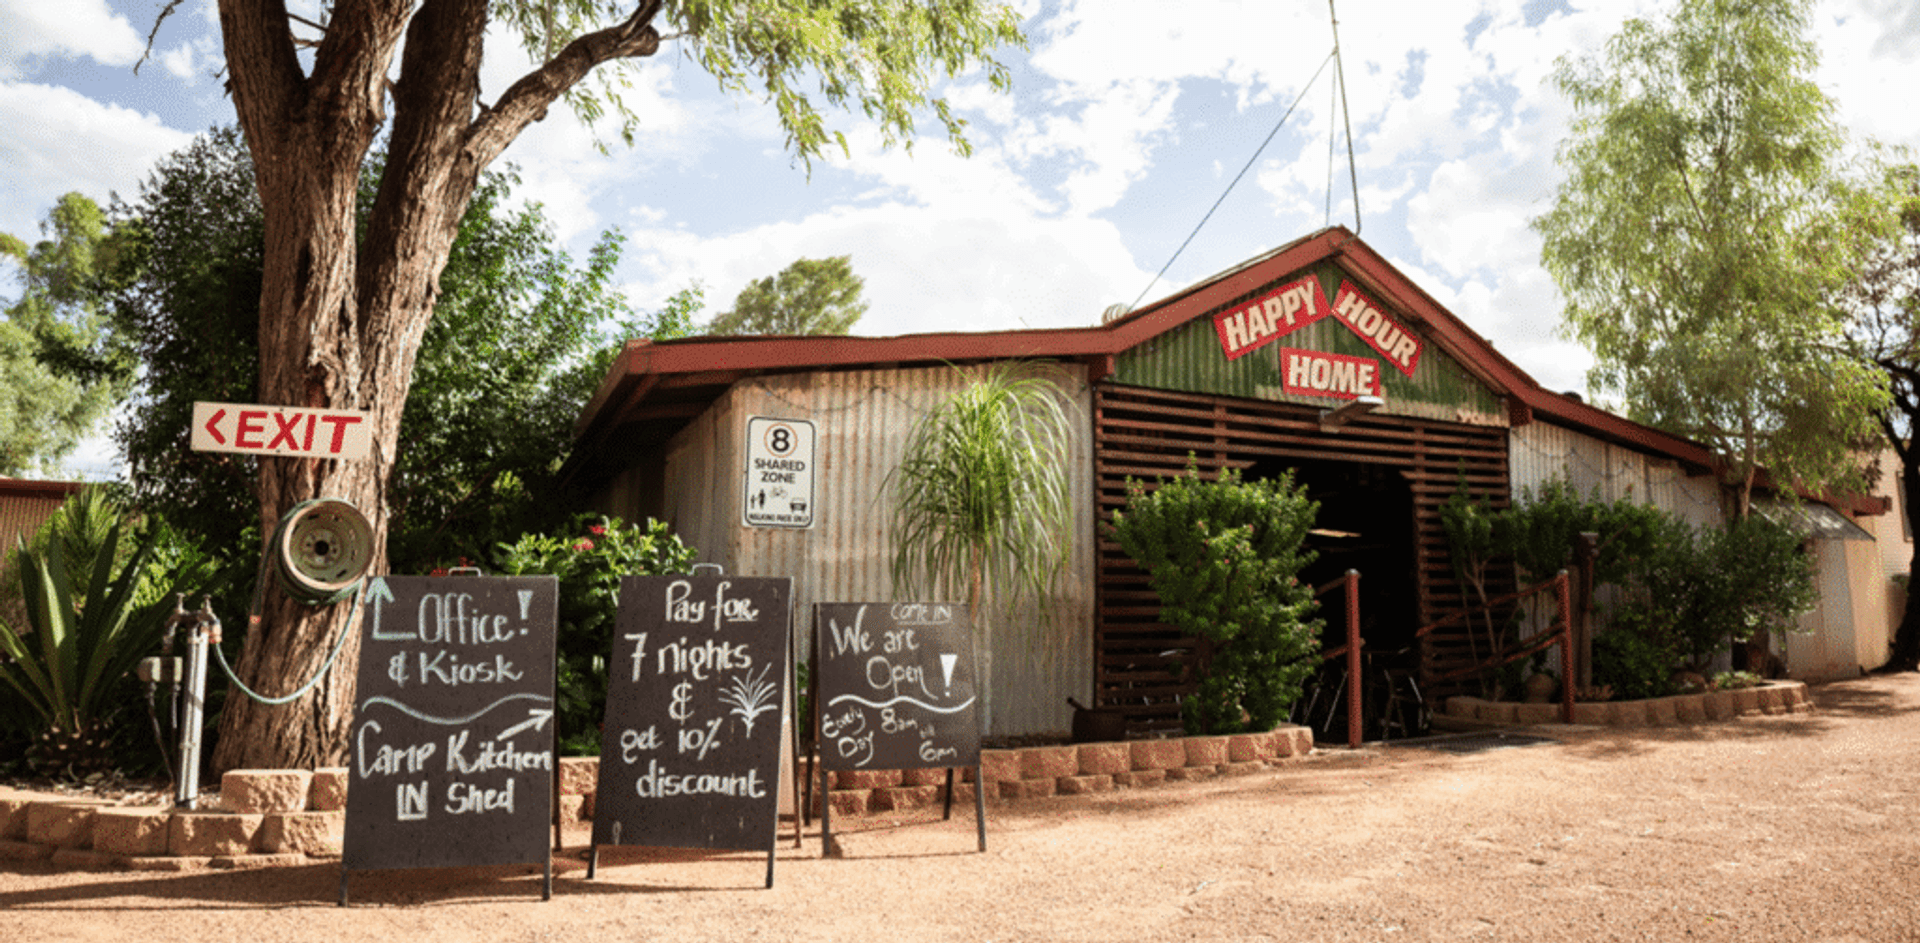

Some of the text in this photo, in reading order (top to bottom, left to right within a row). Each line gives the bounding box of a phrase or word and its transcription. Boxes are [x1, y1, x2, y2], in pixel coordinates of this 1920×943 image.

[1223, 280, 1418, 367] HAPPY HOUR
[1288, 354, 1374, 395] HOME
[235, 410, 362, 453] EXIT
[772, 428, 790, 452] 8
[754, 458, 806, 472] SHARED
[761, 471, 796, 484] ZONE
[665, 580, 706, 623] Pay
[829, 604, 920, 655] We are
[388, 650, 524, 687] & Kiosk
[624, 632, 752, 682] 7 nights
[668, 679, 694, 726] &
[446, 730, 552, 774] Kitchen
[620, 717, 723, 764] get 10%
[919, 740, 957, 762] 6pm
[396, 778, 514, 820] IN Shed
[636, 759, 766, 798] discount
